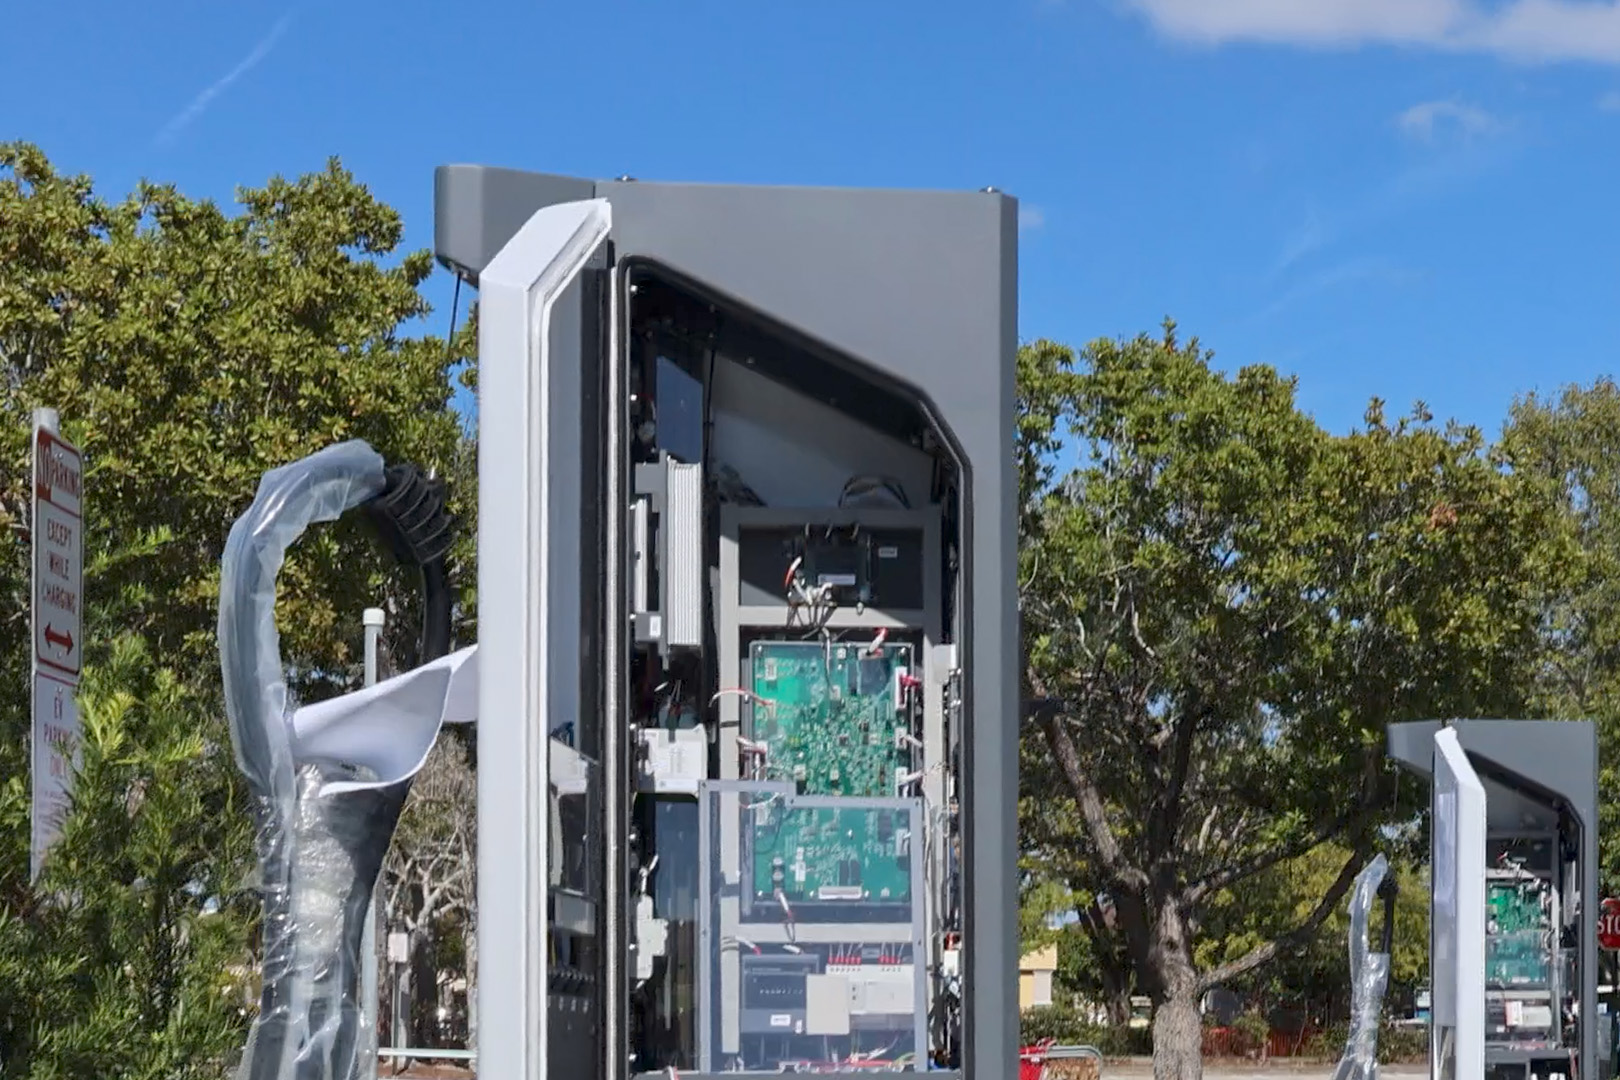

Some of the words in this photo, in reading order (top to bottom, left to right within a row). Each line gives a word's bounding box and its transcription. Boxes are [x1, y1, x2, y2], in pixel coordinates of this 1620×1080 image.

[37, 442, 52, 490] NO
[51, 457, 80, 499] PARKING
[47, 518, 72, 550] EXCEPT
[47, 550, 69, 581] WHILE
[42, 578, 76, 615] CHARGING
[54, 695, 63, 720] EV
[44, 722, 77, 752] PARK
